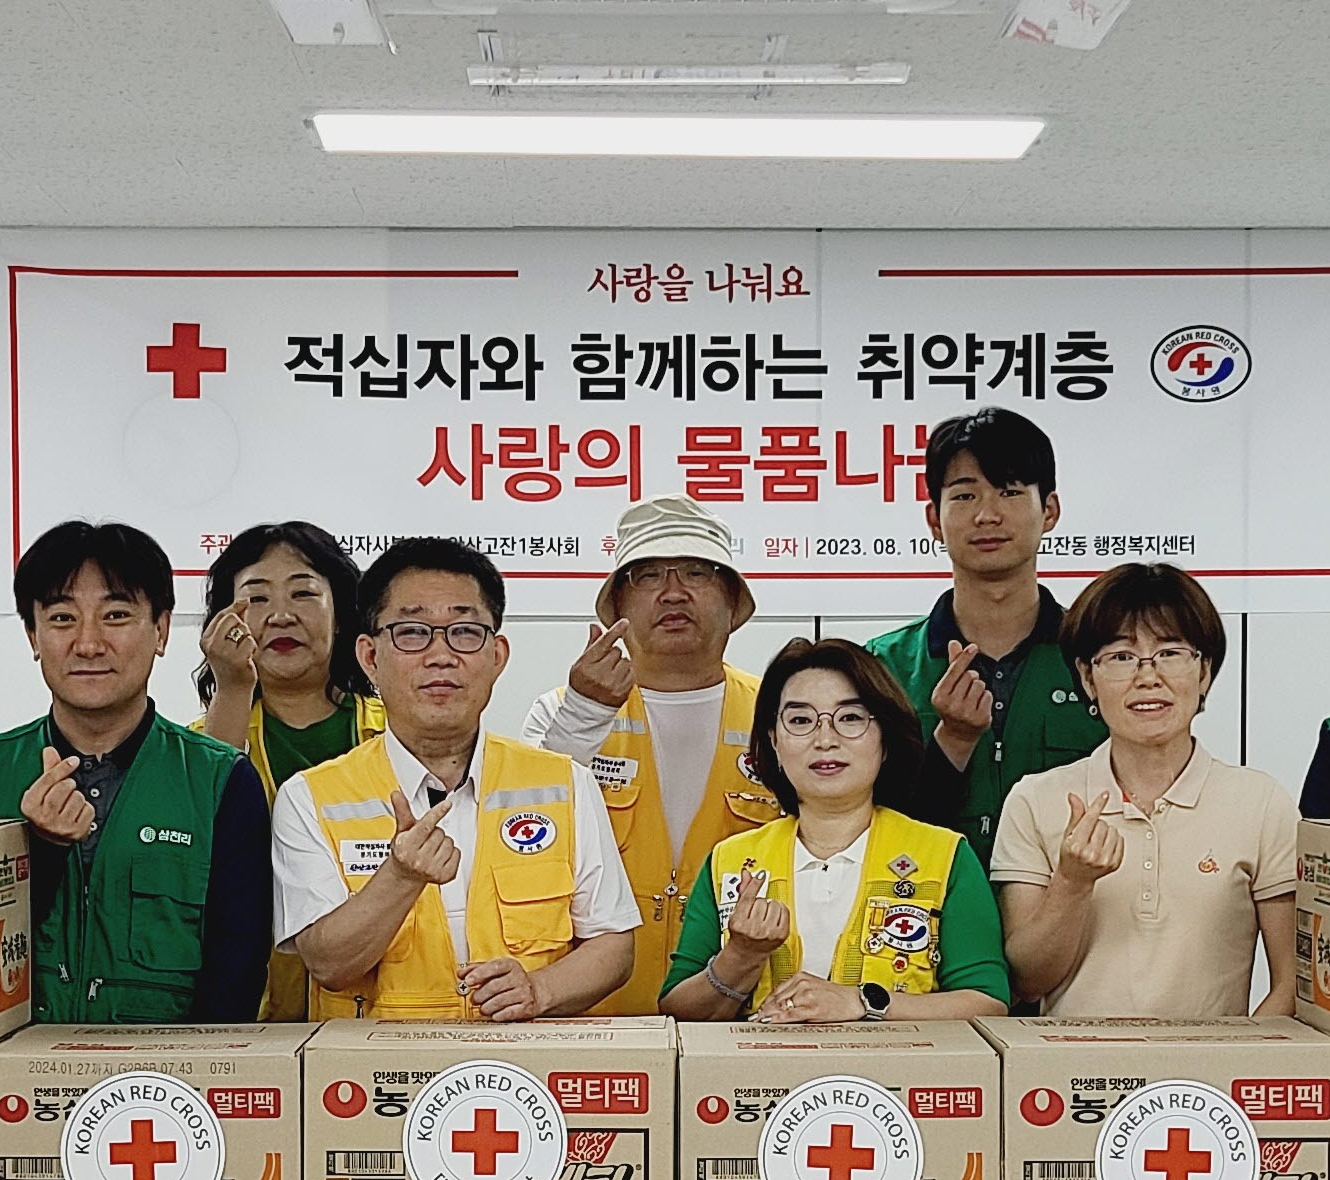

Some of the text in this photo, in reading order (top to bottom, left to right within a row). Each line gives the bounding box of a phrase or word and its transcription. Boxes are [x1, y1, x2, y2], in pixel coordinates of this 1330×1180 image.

[587, 262, 811, 304] 사랑을 나눠요
[1162, 331, 1240, 355] KOREAN RED CROSS
[283, 330, 1114, 402] 적십자와 함께하는 취약계층
[417, 423, 642, 503] 사랑의
[764, 537, 798, 557] 일자
[816, 538, 867, 556] 2023.
[873, 538, 901, 556] 08.
[1094, 535, 1195, 556] 행정복지센터
[158, 829, 192, 846] 삼천리
[214, 1091, 276, 1118] 멀티팩
[416, 1073, 554, 1142] KOREAN RED CROSS
[554, 1077, 640, 1111] 멀티팩
[1237, 1084, 1323, 1118] 멀티팩
[74, 1084, 211, 1155] KOREAN RED CROSS
[1109, 1093, 1247, 1162] KOREAN RED CROSS
